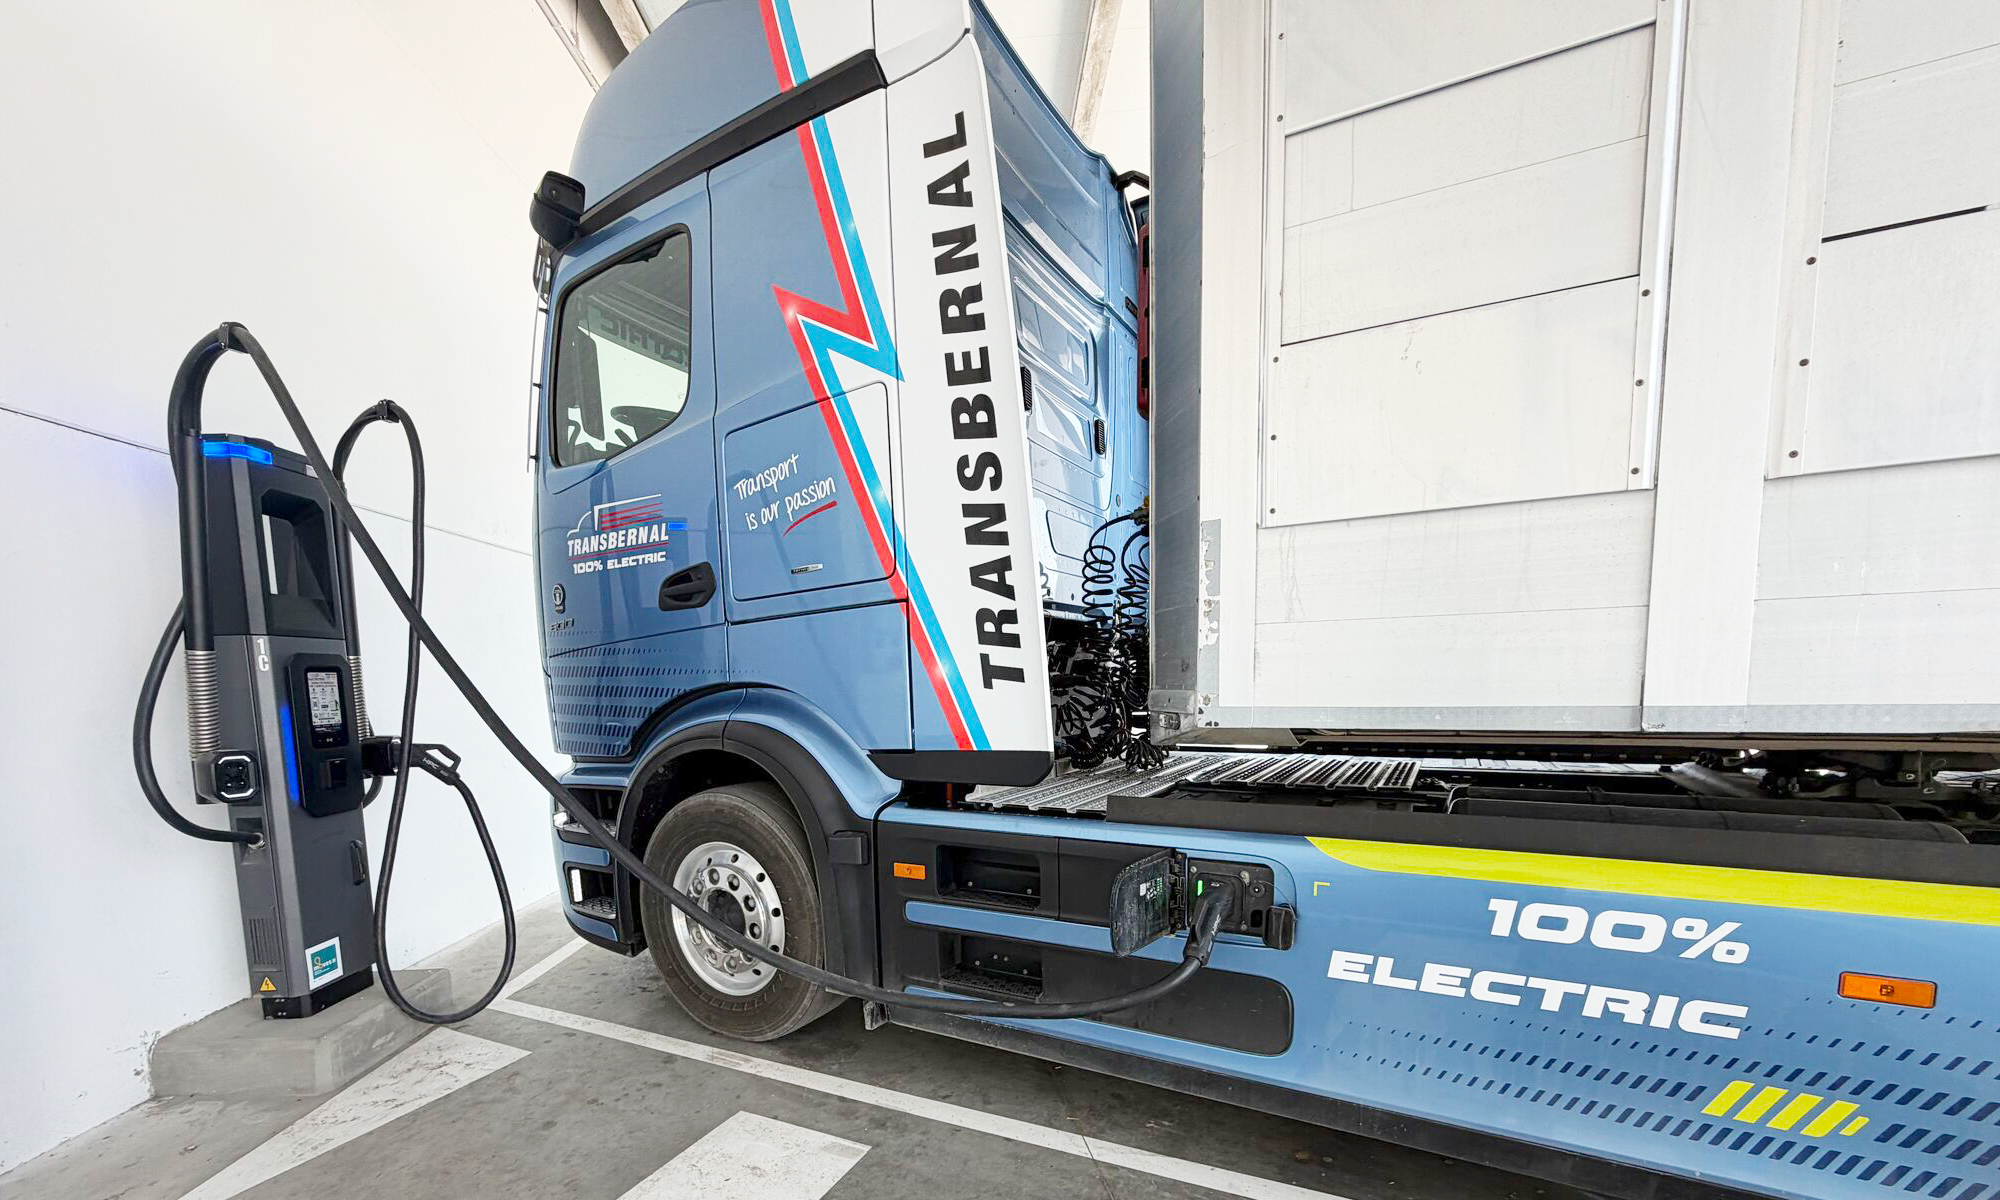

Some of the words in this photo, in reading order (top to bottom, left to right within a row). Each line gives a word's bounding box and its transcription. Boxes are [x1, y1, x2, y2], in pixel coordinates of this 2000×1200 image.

[922, 111, 1025, 689] TRANSBERNAL
[734, 453, 799, 501] Transport
[745, 512, 758, 531] is
[760, 500, 780, 526] our
[785, 476, 836, 521] passion
[567, 523, 669, 556] TRANSBERNAL
[573, 560, 604, 575] 100%
[607, 551, 666, 570] ELECTRIC
[256, 638, 265, 655] 1
[258, 655, 270, 672] C
[1488, 898, 1750, 964] 100%
[1327, 950, 1750, 1040] ELECTRIC
